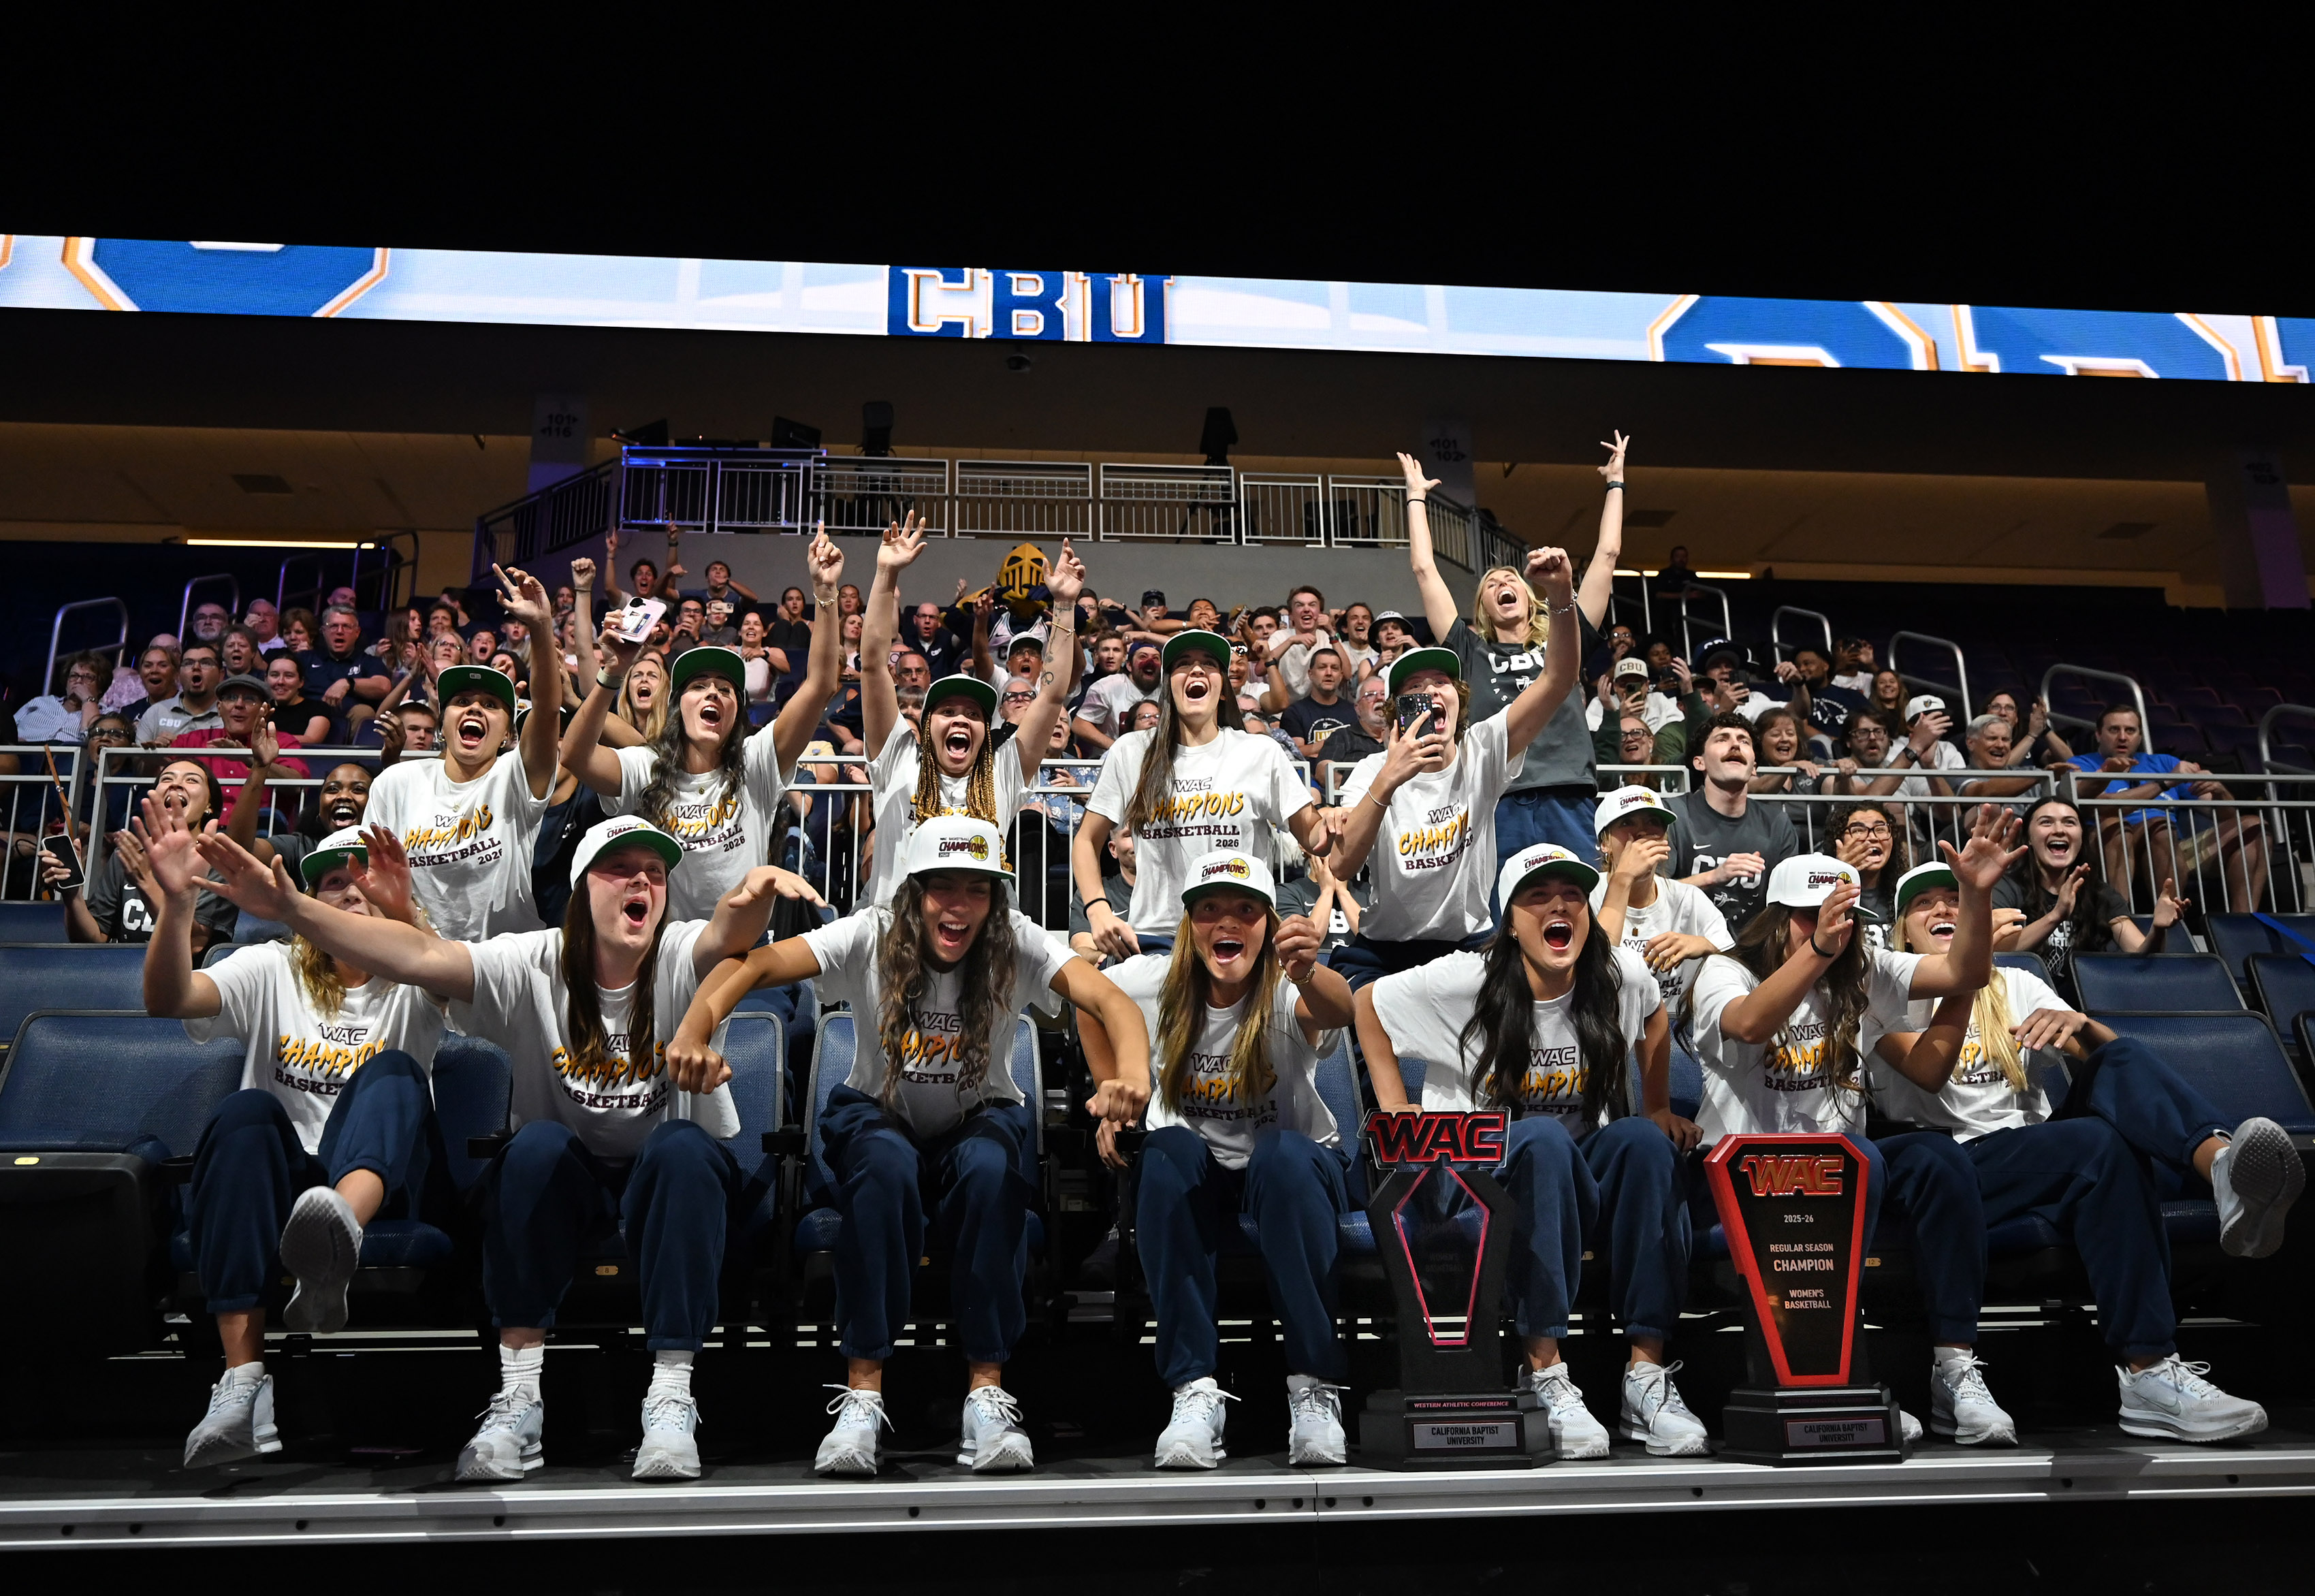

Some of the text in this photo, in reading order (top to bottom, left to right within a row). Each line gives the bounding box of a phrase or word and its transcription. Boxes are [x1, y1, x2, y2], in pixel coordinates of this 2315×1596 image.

[889, 266, 1169, 344] CBU
[547, 413, 571, 425] 101
[547, 426, 571, 437] 116
[1435, 438, 1457, 449] 101
[1620, 663, 1642, 672] CBU
[159, 718, 182, 728] CBU
[1175, 777, 1212, 793] WAC
[1150, 791, 1244, 827] HAMPIONS
[1143, 825, 1240, 840] BASKETBALL
[723, 835, 746, 852] 2026
[939, 842, 985, 855] CHAMPIONS
[1215, 839, 1239, 848] 2026
[1202, 865, 1245, 878] CHAMPIONS
[318, 1023, 368, 1046] WAC
[1367, 1113, 1505, 1163] WAC
[1740, 1155, 1844, 1196] WAC
[1784, 1214, 1814, 1223] 2025-26
[1770, 1243, 1834, 1252] REGULAR SEASON
[1774, 1259, 1834, 1271] CHAMPION
[1789, 1290, 1824, 1298] WOMEN'S
[1785, 1300, 1832, 1309] BASKETBALL
[1431, 1426, 1499, 1435] CALIFORNIA BAPTIST
[1804, 1423, 1868, 1433] CALIFORNIA BAPTIST
[1447, 1437, 1484, 1445] UNIVERSITY
[1819, 1434, 1855, 1443] UNIVERSITY
